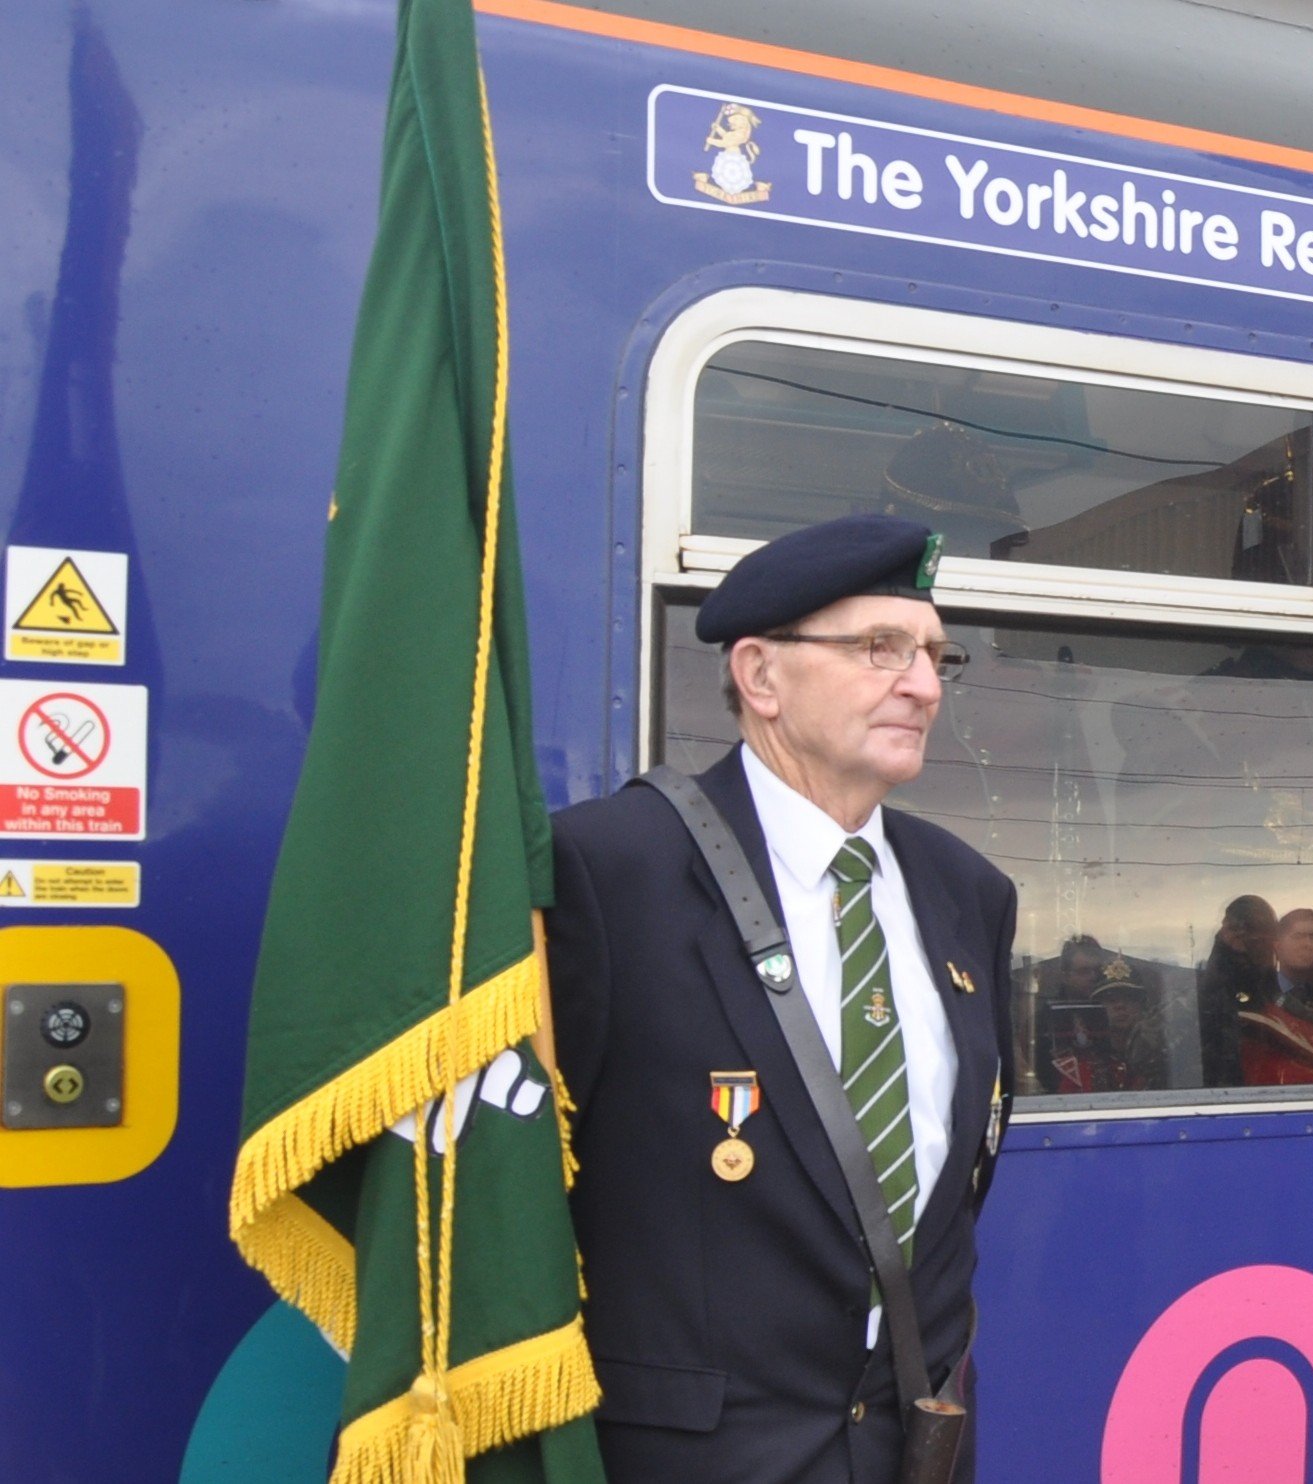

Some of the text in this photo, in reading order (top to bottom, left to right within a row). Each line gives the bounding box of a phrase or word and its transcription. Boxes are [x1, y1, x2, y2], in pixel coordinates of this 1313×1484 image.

[793, 128, 924, 211] The
[944, 154, 1240, 261] Yorkshire
[16, 786, 112, 805] No Smoking
[21, 802, 106, 818] in any area
[3, 818, 123, 832] within this train
[65, 866, 106, 875] Caution
